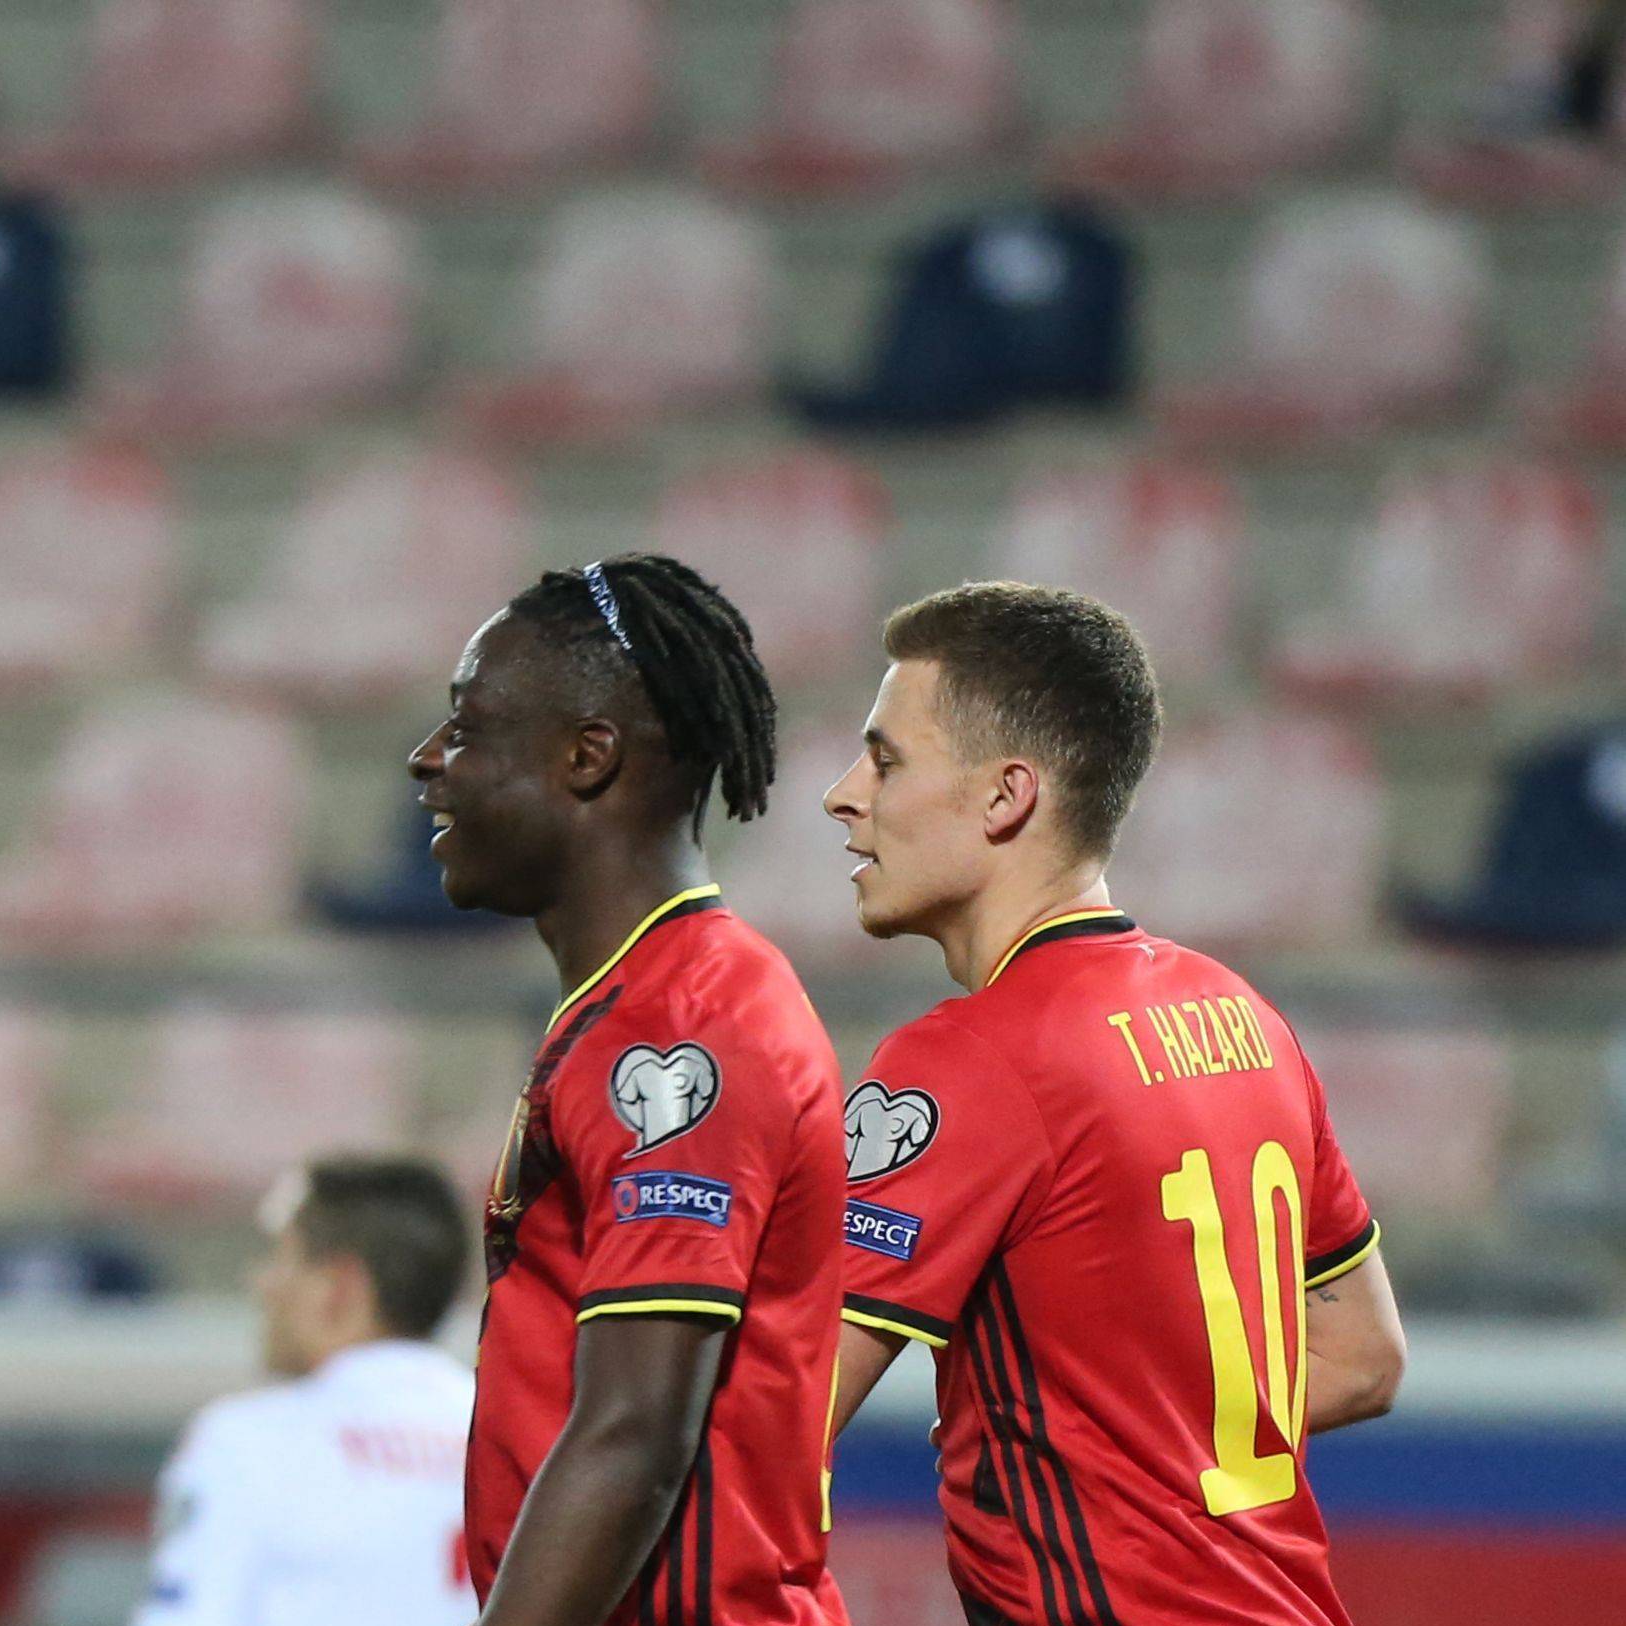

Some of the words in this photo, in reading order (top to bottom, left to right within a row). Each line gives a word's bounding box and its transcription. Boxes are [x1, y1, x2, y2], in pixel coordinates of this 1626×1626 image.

[1107, 1010, 1165, 1086] T.
[1146, 995, 1274, 1079] HAZARD
[640, 1184, 731, 1214] RESPECT
[1160, 1140, 1307, 1517] 10
